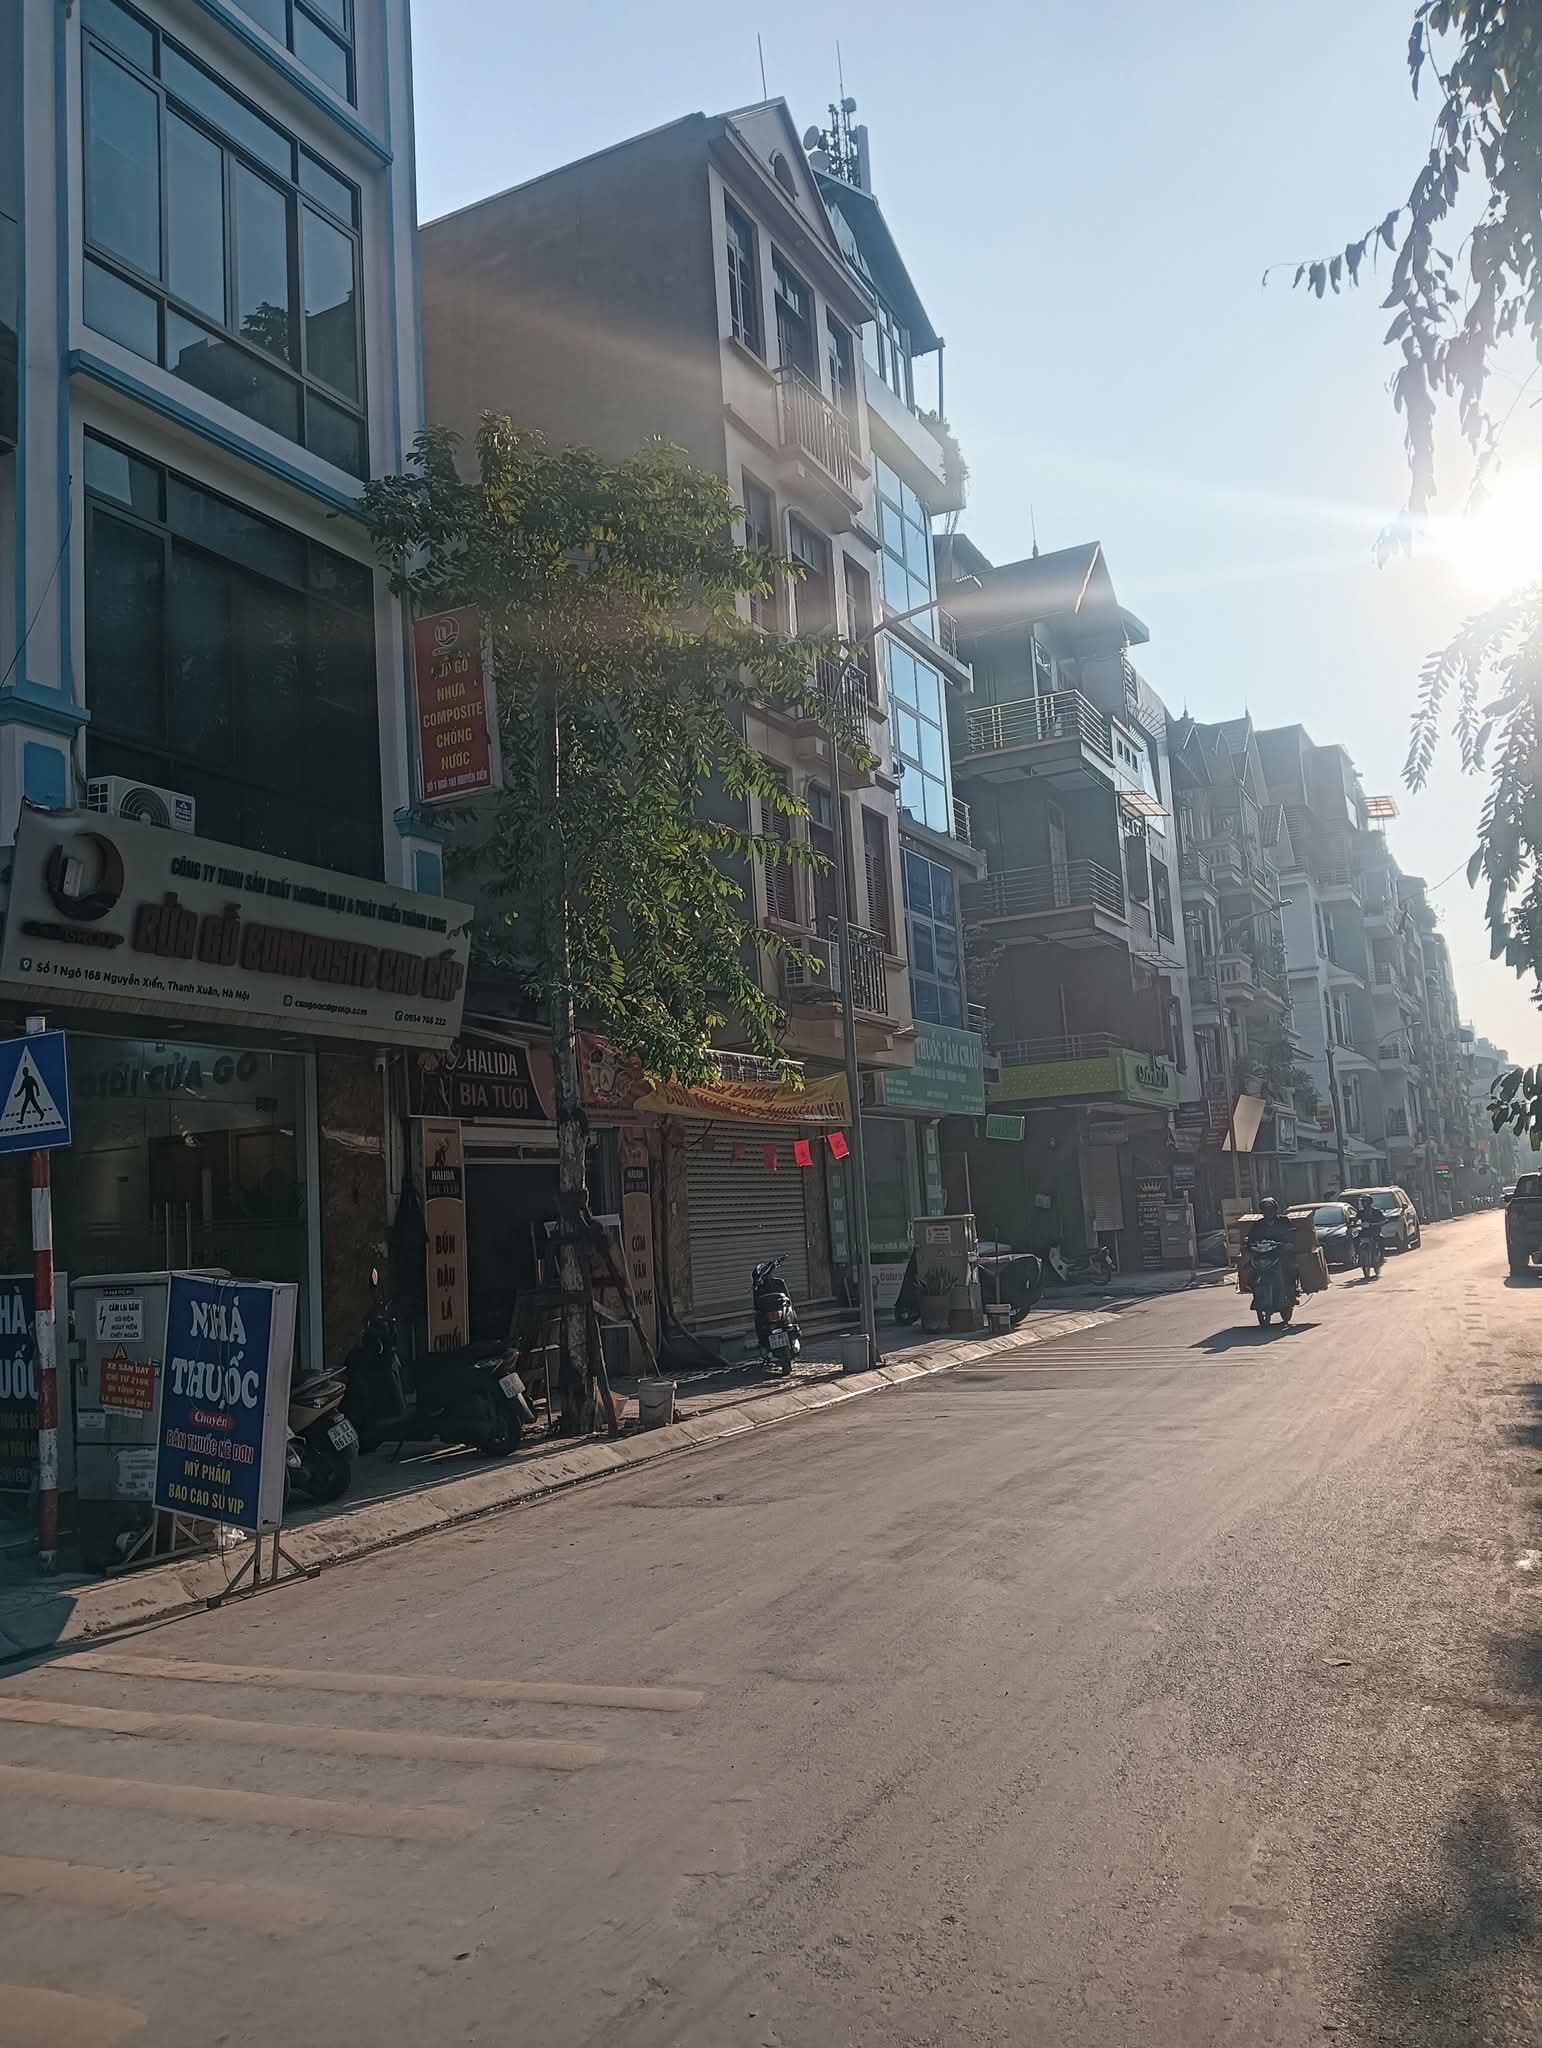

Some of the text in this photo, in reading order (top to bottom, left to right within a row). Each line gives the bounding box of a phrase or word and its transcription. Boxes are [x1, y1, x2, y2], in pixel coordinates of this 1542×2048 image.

[436, 682, 466, 702] NHỰA
[423, 700, 483, 729] COMPOSITE
[436, 726, 472, 749] CHỐNG
[441, 751, 470, 771] NƯỚC
[170, 856, 201, 880] CÔNG
[202, 863, 217, 883] TY
[241, 922, 377, 989] COMPOSITE
[37, 961, 51, 974] Số
[53, 965, 58, 975] 1
[84, 969, 101, 981] 168
[102, 972, 140, 987] Nguyễn
[167, 980, 195, 994] Thanh
[196, 984, 220, 999] Xuân,
[221, 987, 234, 999] Hà
[235, 989, 251, 1002] Nội
[466, 1048, 519, 1078] HALIDA
[460, 1081, 488, 1107] BIA
[431, 1168, 456, 1181] HALIDA
[436, 1231, 455, 1255] BÚN
[171, 1350, 259, 1409] THUỐC
[193, 1409, 229, 1429] Chuyên
[166, 1428, 186, 1450] BÁN
[186, 1432, 217, 1457] THUỐC
[184, 1459, 200, 1478] MỸ
[168, 1482, 245, 1515] BAO CAO SU VIP
